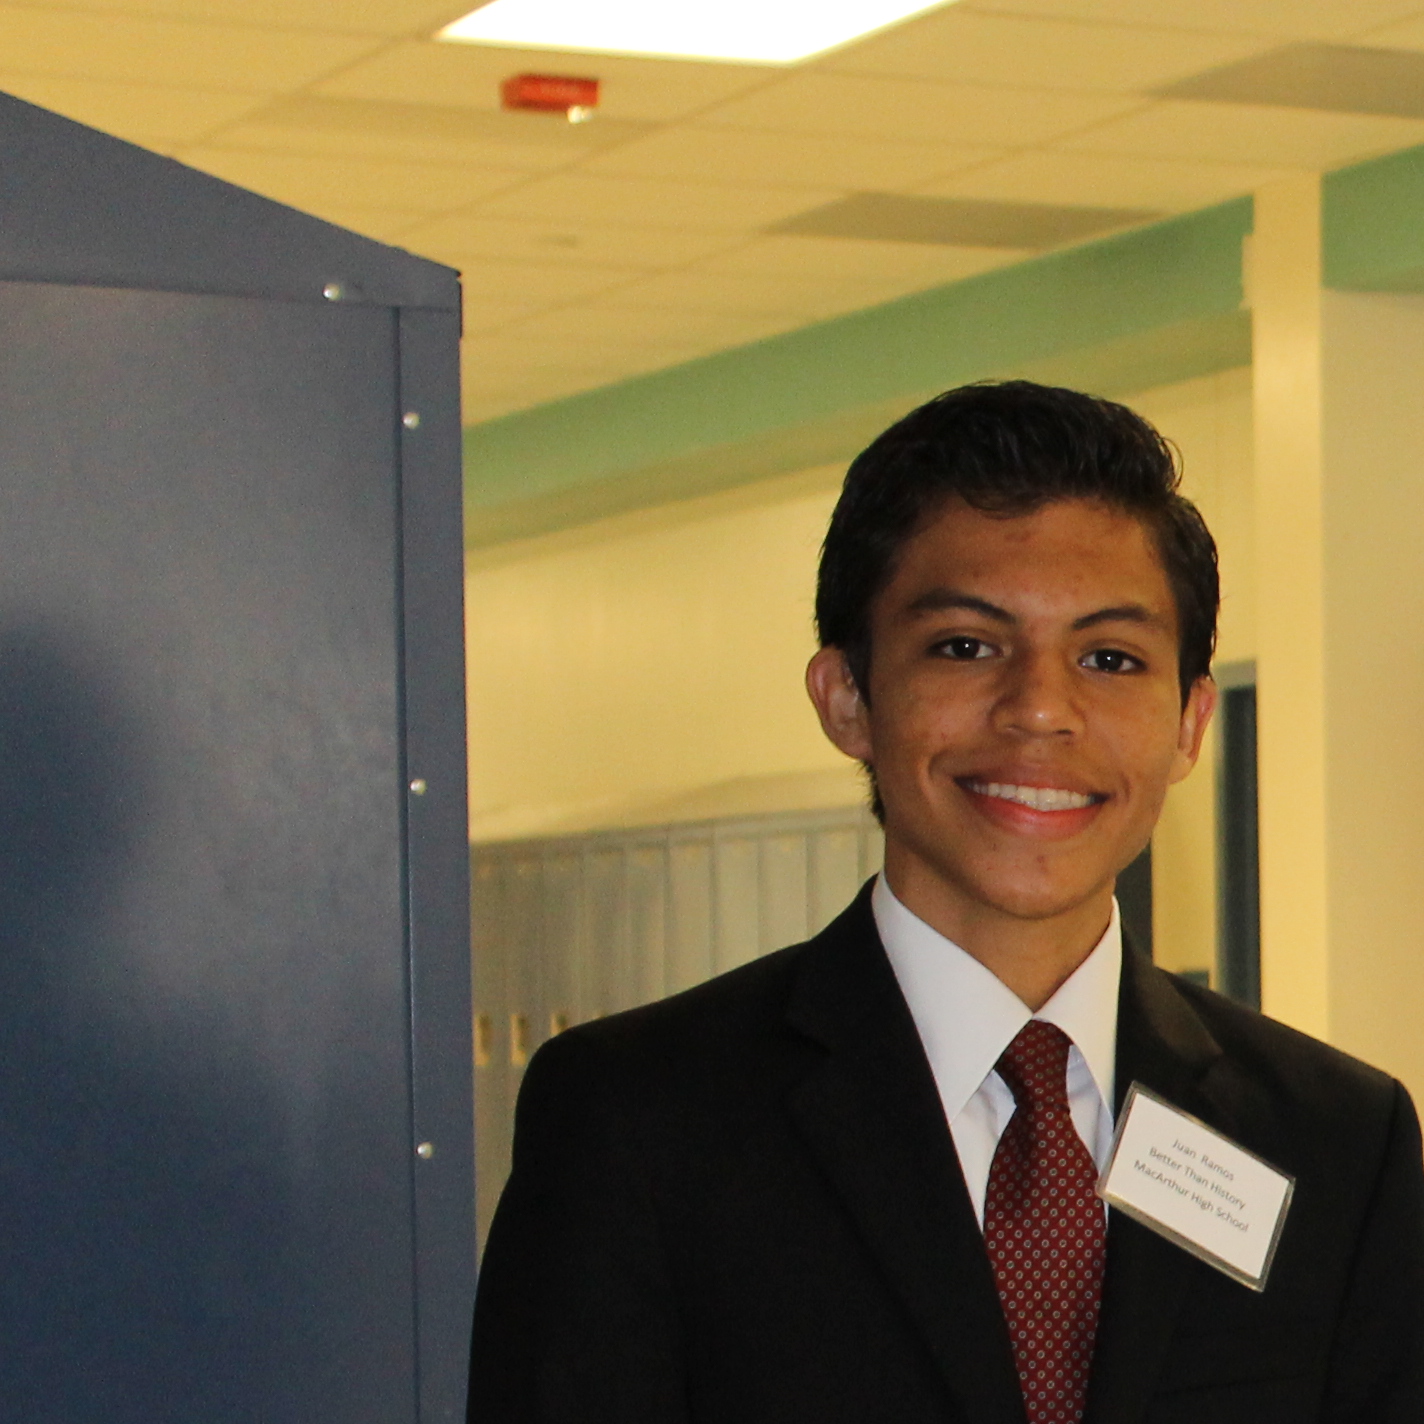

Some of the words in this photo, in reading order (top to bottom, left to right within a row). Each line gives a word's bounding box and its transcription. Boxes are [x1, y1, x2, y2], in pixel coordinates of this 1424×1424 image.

[1150, 1148, 1181, 1170] Better
[1185, 1167, 1208, 1186] Than
[1211, 1183, 1245, 1209] History
[1173, 1139, 1196, 1158] Juan
[1202, 1155, 1234, 1180] Ramos
[1134, 1160, 1189, 1196] MacArthur
[1191, 1194, 1214, 1211] High
[1217, 1208, 1249, 1232] School
